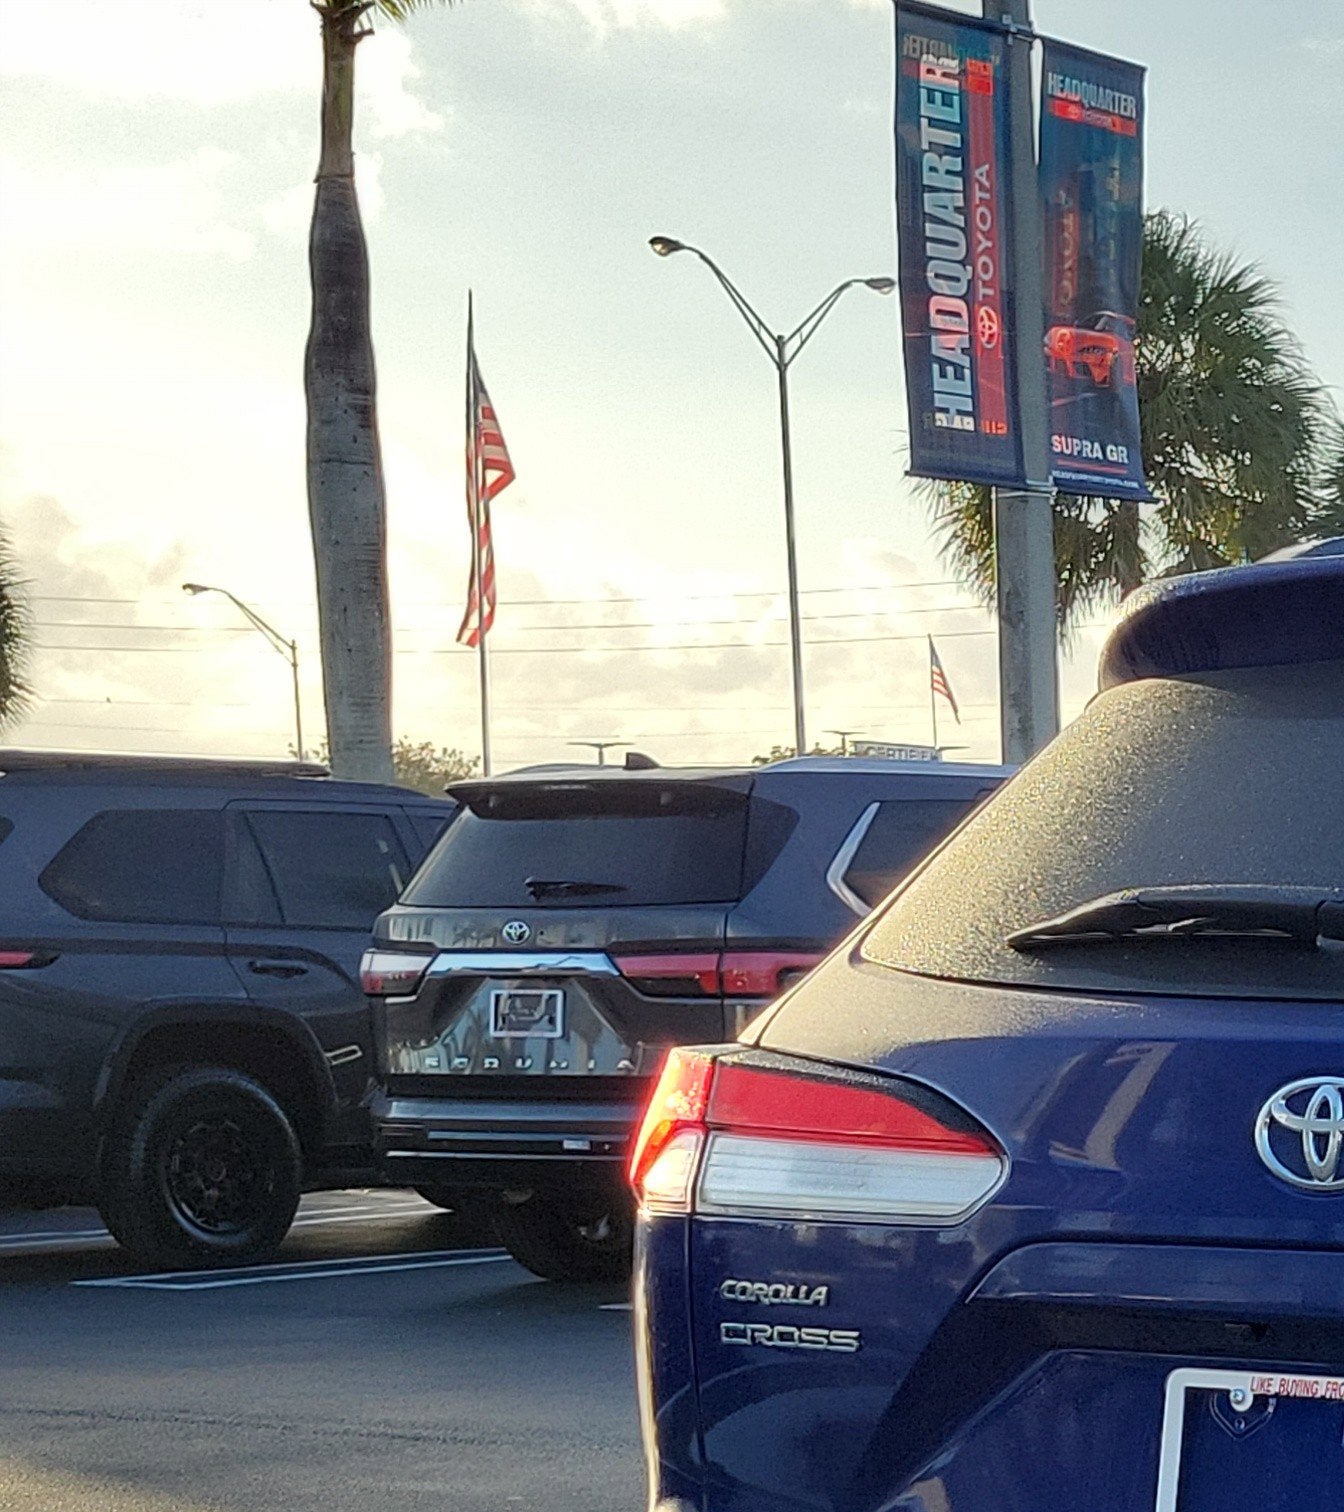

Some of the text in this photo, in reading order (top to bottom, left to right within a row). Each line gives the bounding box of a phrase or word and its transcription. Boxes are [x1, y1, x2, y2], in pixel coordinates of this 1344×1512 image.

[1047, 72, 1136, 120] HEADQUARTER
[919, 54, 975, 432] HEADQUARTER
[975, 163, 995, 302] TOYOTA
[1051, 434, 1129, 464] SUPRA GR
[720, 1279, 828, 1307] COROLLA
[720, 1322, 860, 1352] CROSS
[1250, 1376, 1274, 1393] LIKE
[1278, 1377, 1319, 1397] BUYING
